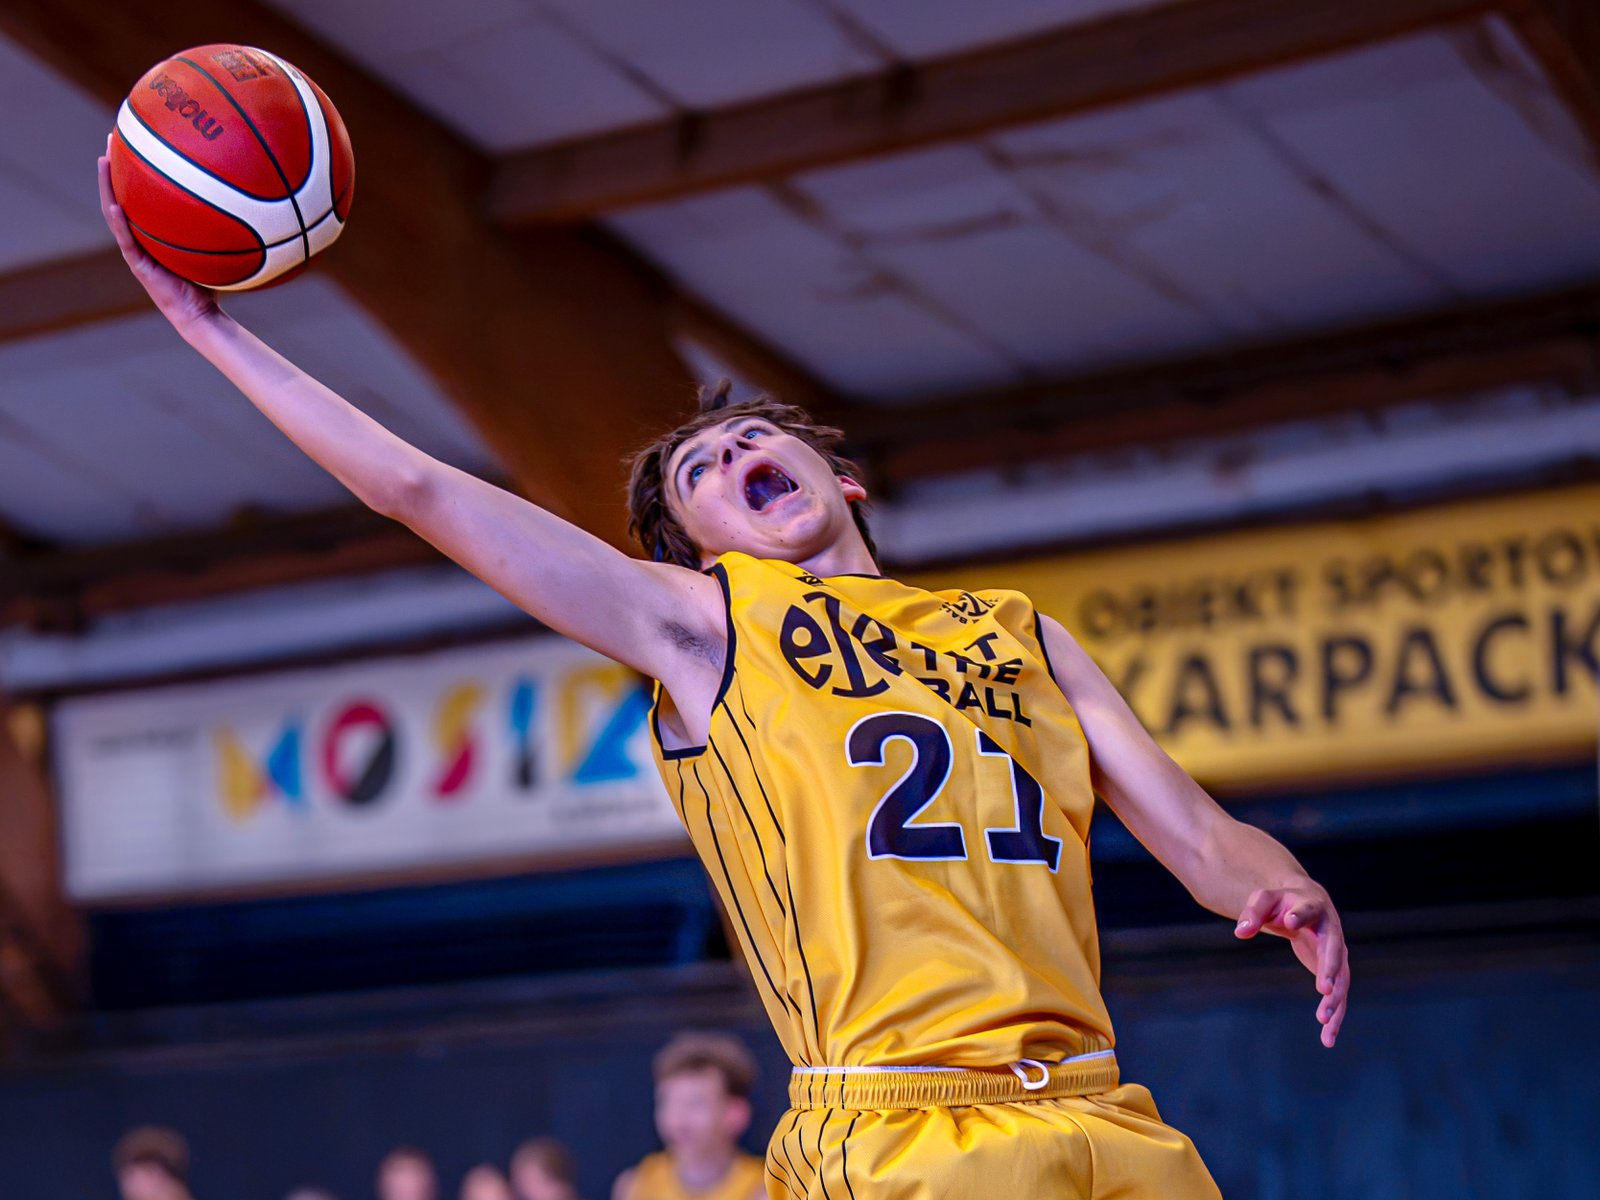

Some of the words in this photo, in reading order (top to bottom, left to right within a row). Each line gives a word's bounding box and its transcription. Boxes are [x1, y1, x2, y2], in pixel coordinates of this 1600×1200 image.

[1322, 528, 1600, 612] SPORTO
[916, 677, 1032, 728] BALL
[845, 711, 1062, 874] 21
